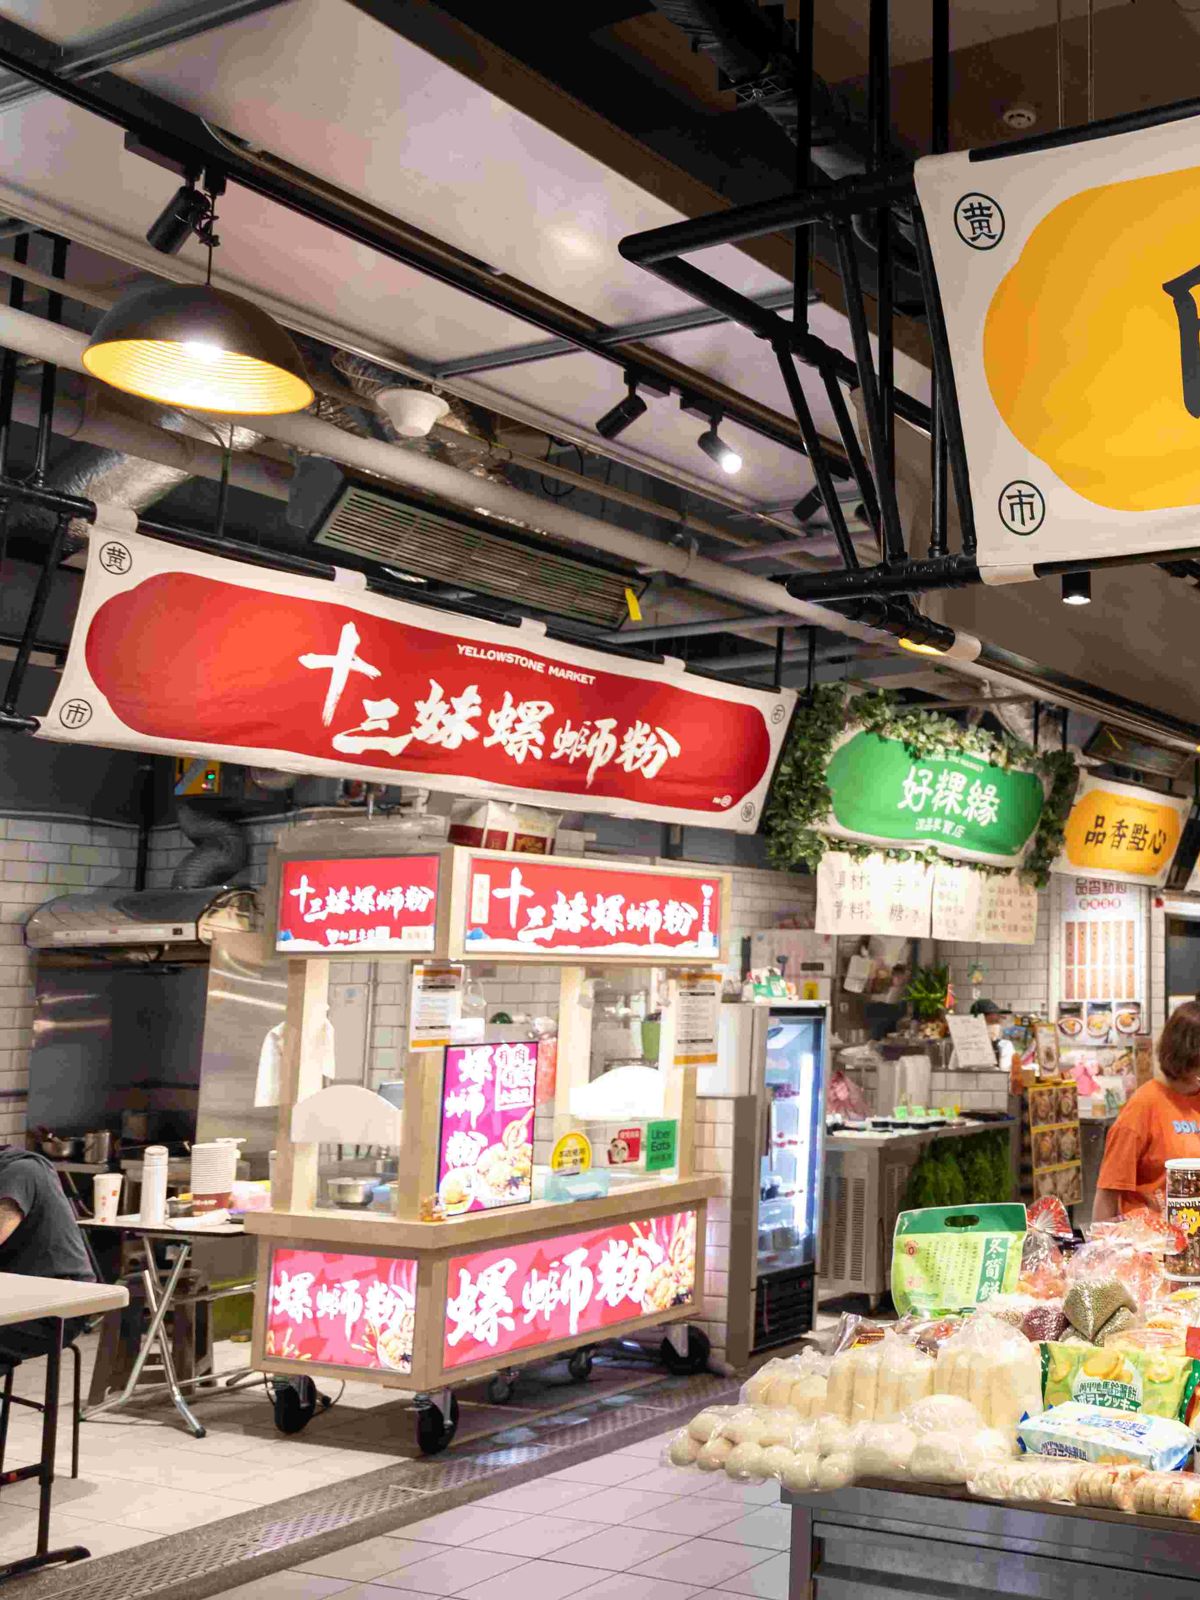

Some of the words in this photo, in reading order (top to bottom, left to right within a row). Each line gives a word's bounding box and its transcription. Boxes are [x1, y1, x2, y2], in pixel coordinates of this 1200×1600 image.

[1003, 487, 1038, 529] 市
[456, 643, 546, 674] YELLOWSTONE
[547, 665, 597, 686] MARKET
[64, 702, 90, 726] 市
[299, 621, 681, 789] 十三妹螺螄粉
[896, 765, 1001, 827] 好粿緣
[1084, 814, 1167, 855] 品香點心
[650, 1141, 671, 1152] Eats
[651, 1129, 672, 1140] Uber
